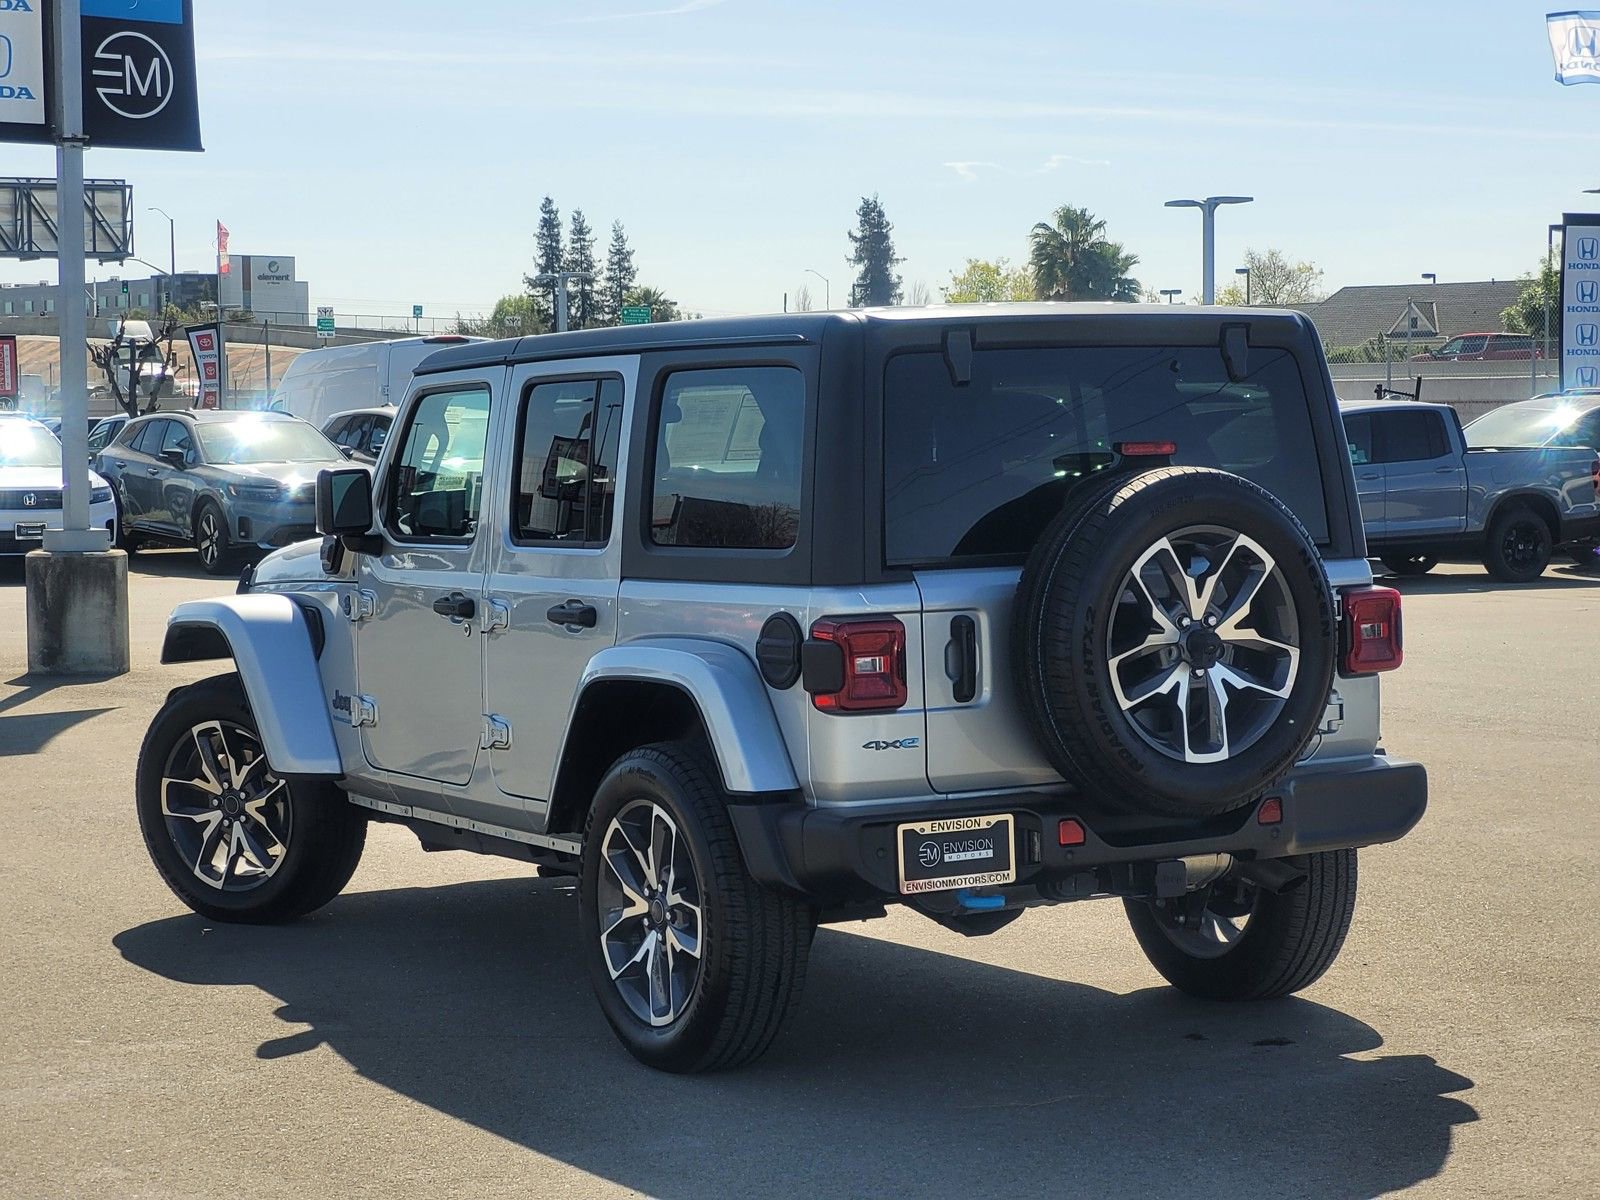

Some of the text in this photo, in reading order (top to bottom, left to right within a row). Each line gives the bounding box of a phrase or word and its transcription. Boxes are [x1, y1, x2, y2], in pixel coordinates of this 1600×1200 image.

[0, 0, 33, 12] DA
[0, 85, 36, 100] DA
[1567, 262, 1600, 270] HOND
[257, 273, 290, 281] element
[1566, 305, 1600, 313] HOND
[1566, 348, 1600, 356] HOND
[332, 689, 352, 716] Jee
[930, 818, 981, 832] ENVISION
[943, 838, 993, 853] ENVISION
[948, 851, 990, 860] MOTORS
[906, 873, 1010, 892] ENVISIONMOTORS.COM
